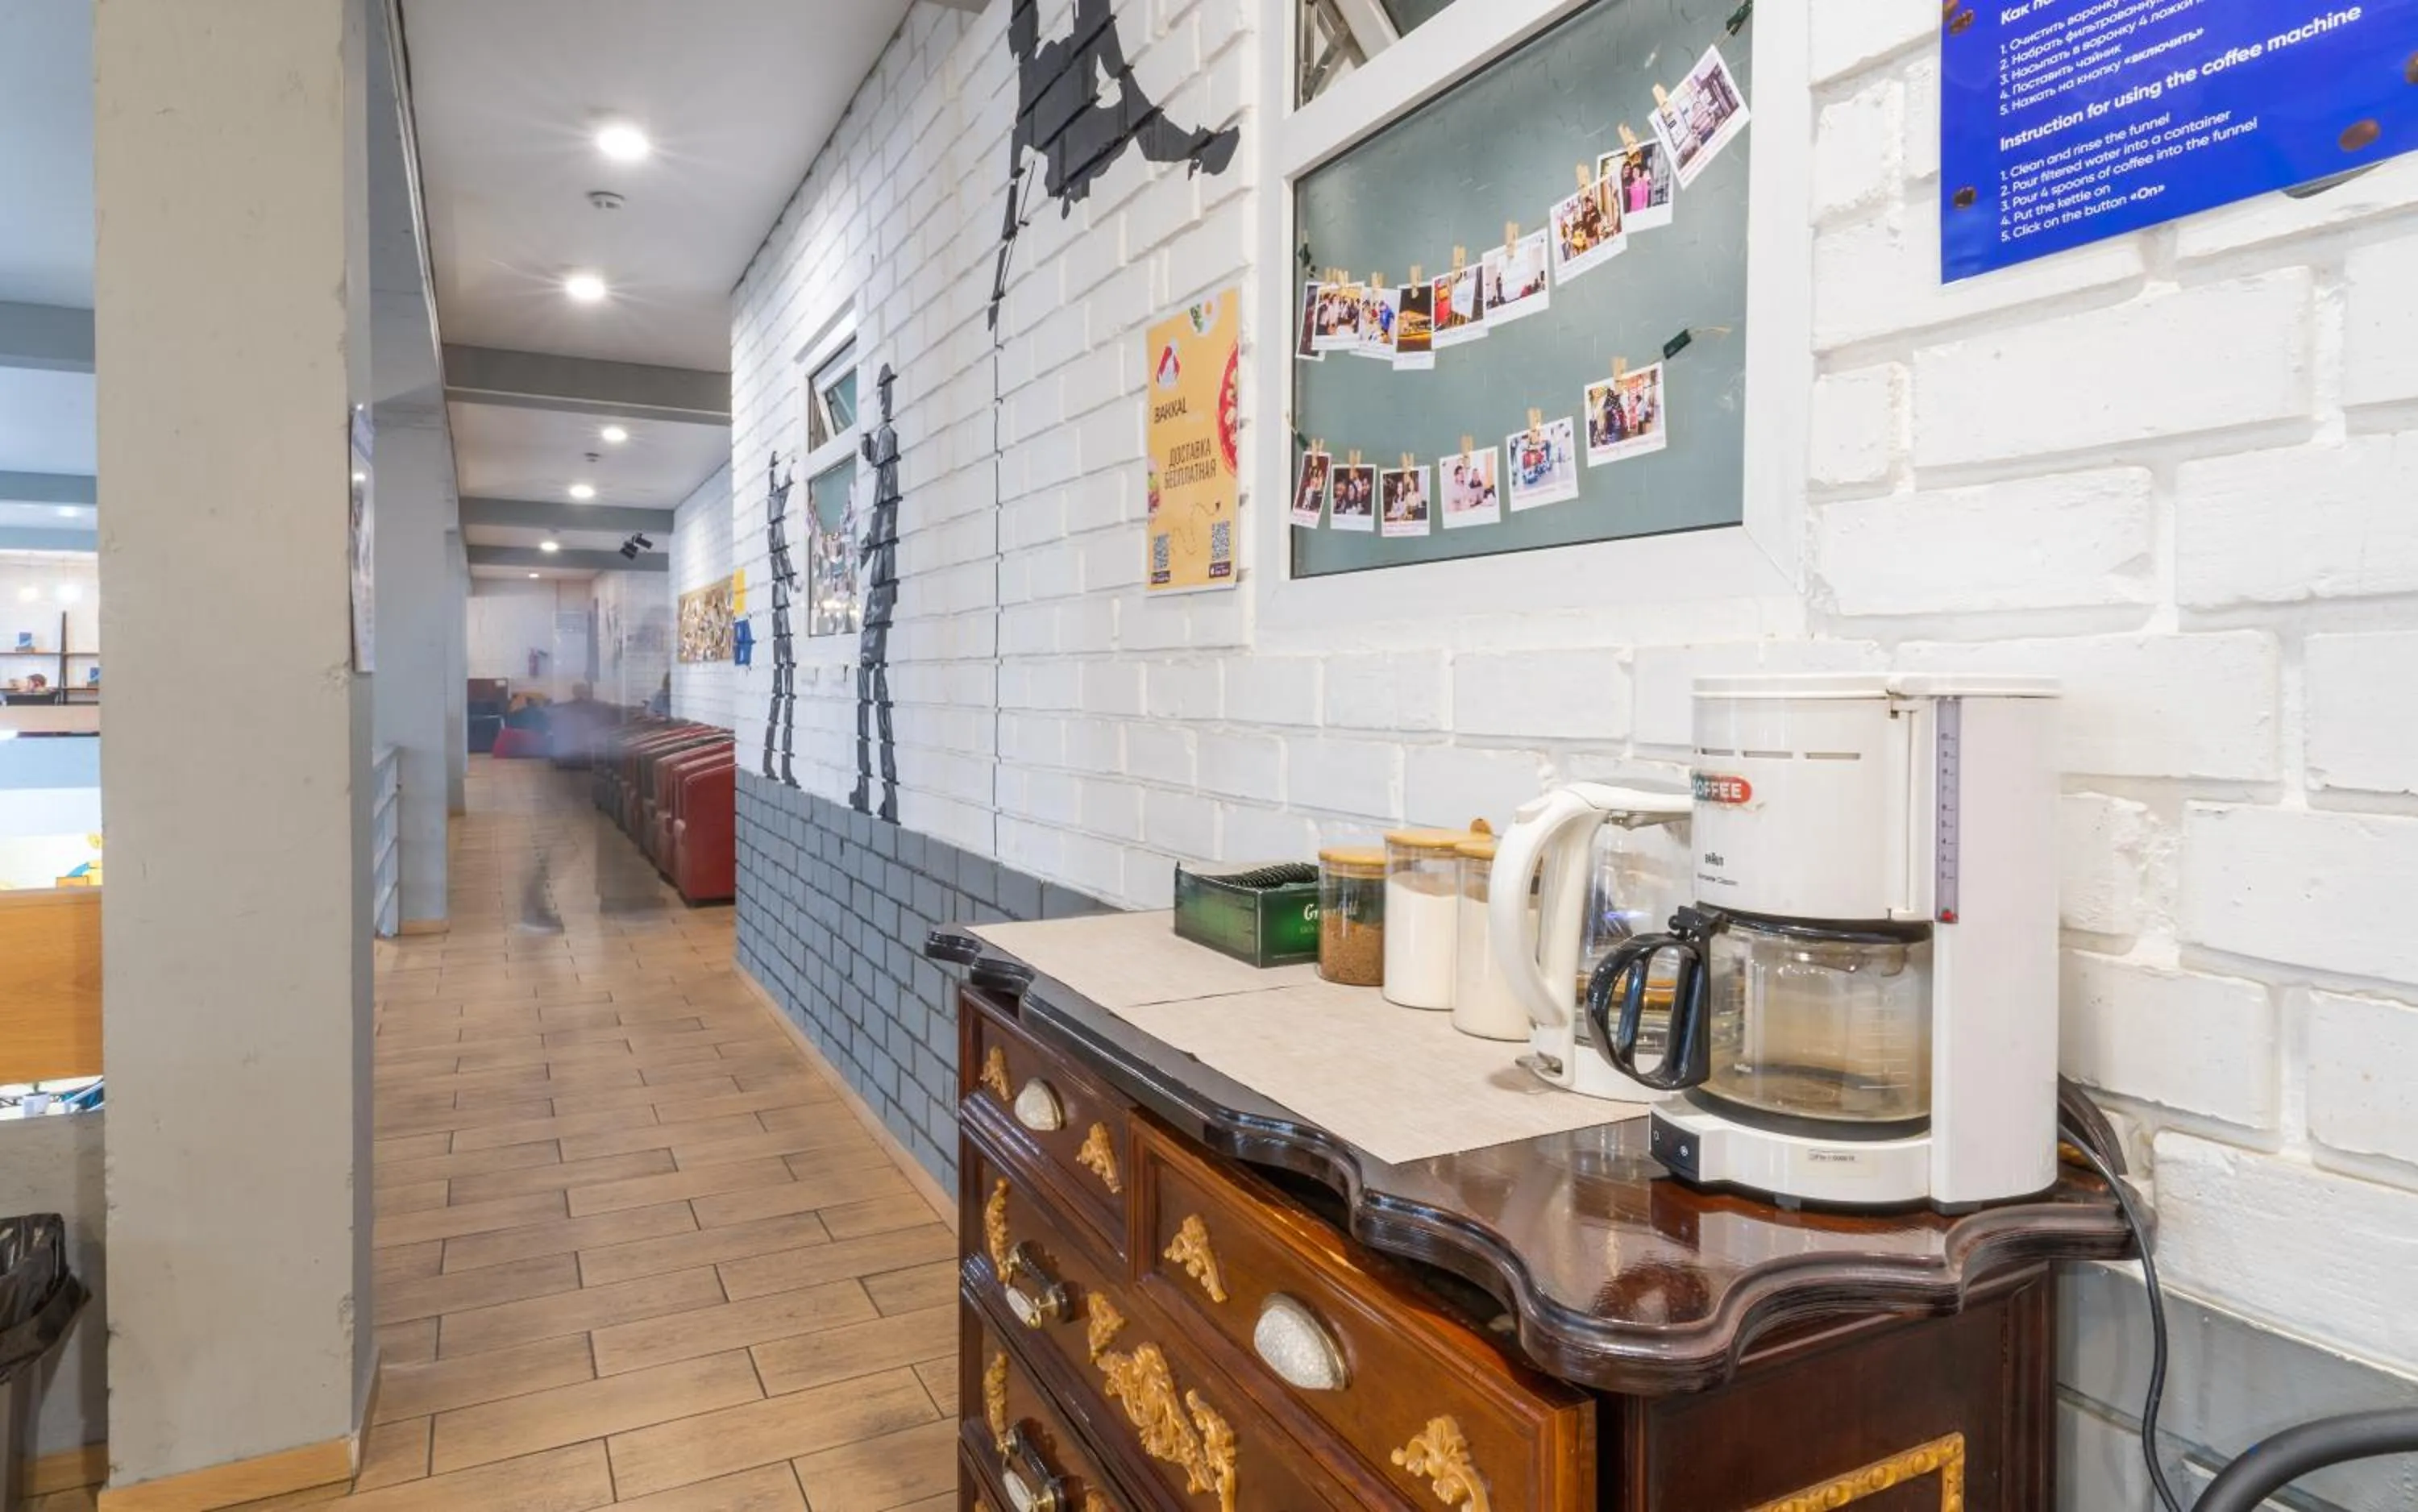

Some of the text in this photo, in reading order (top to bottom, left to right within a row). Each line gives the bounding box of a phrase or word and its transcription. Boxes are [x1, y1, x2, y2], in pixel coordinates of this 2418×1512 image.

[2001, 3, 2030, 25] Как
[2010, 22, 2065, 50] Очистить
[2067, 0, 2119, 26] воронку
[2012, 51, 2071, 80] Насыпать
[2083, 21, 2136, 51] воронку
[2138, 15, 2148, 26] 4
[2012, 38, 2063, 64] Набрать
[2013, 65, 2074, 94] Поставить
[2076, 44, 2121, 68] чайник
[2000, 6, 2362, 152] Instruction for using the coffee machine
[2012, 88, 2056, 110] Нажать
[2059, 80, 2074, 92] на
[2077, 60, 2121, 84] кнопку
[2000, 111, 2170, 181] 1. Clean and rinse the funnel
[2000, 110, 2231, 197] 2. Pour filtered water into a container
[2000, 116, 2257, 211] 3. Pour 4 spoons of coffee into the funnel
[2000, 185, 2111, 226] 4. Put the kettle on
[2000, 230, 2010, 242] 5.
[2013, 222, 2041, 237] Click
[2044, 218, 2059, 228] on
[2062, 210, 2082, 223] the
[2084, 196, 2127, 217] button
[1169, 438, 1211, 467] ДОСТАВКА
